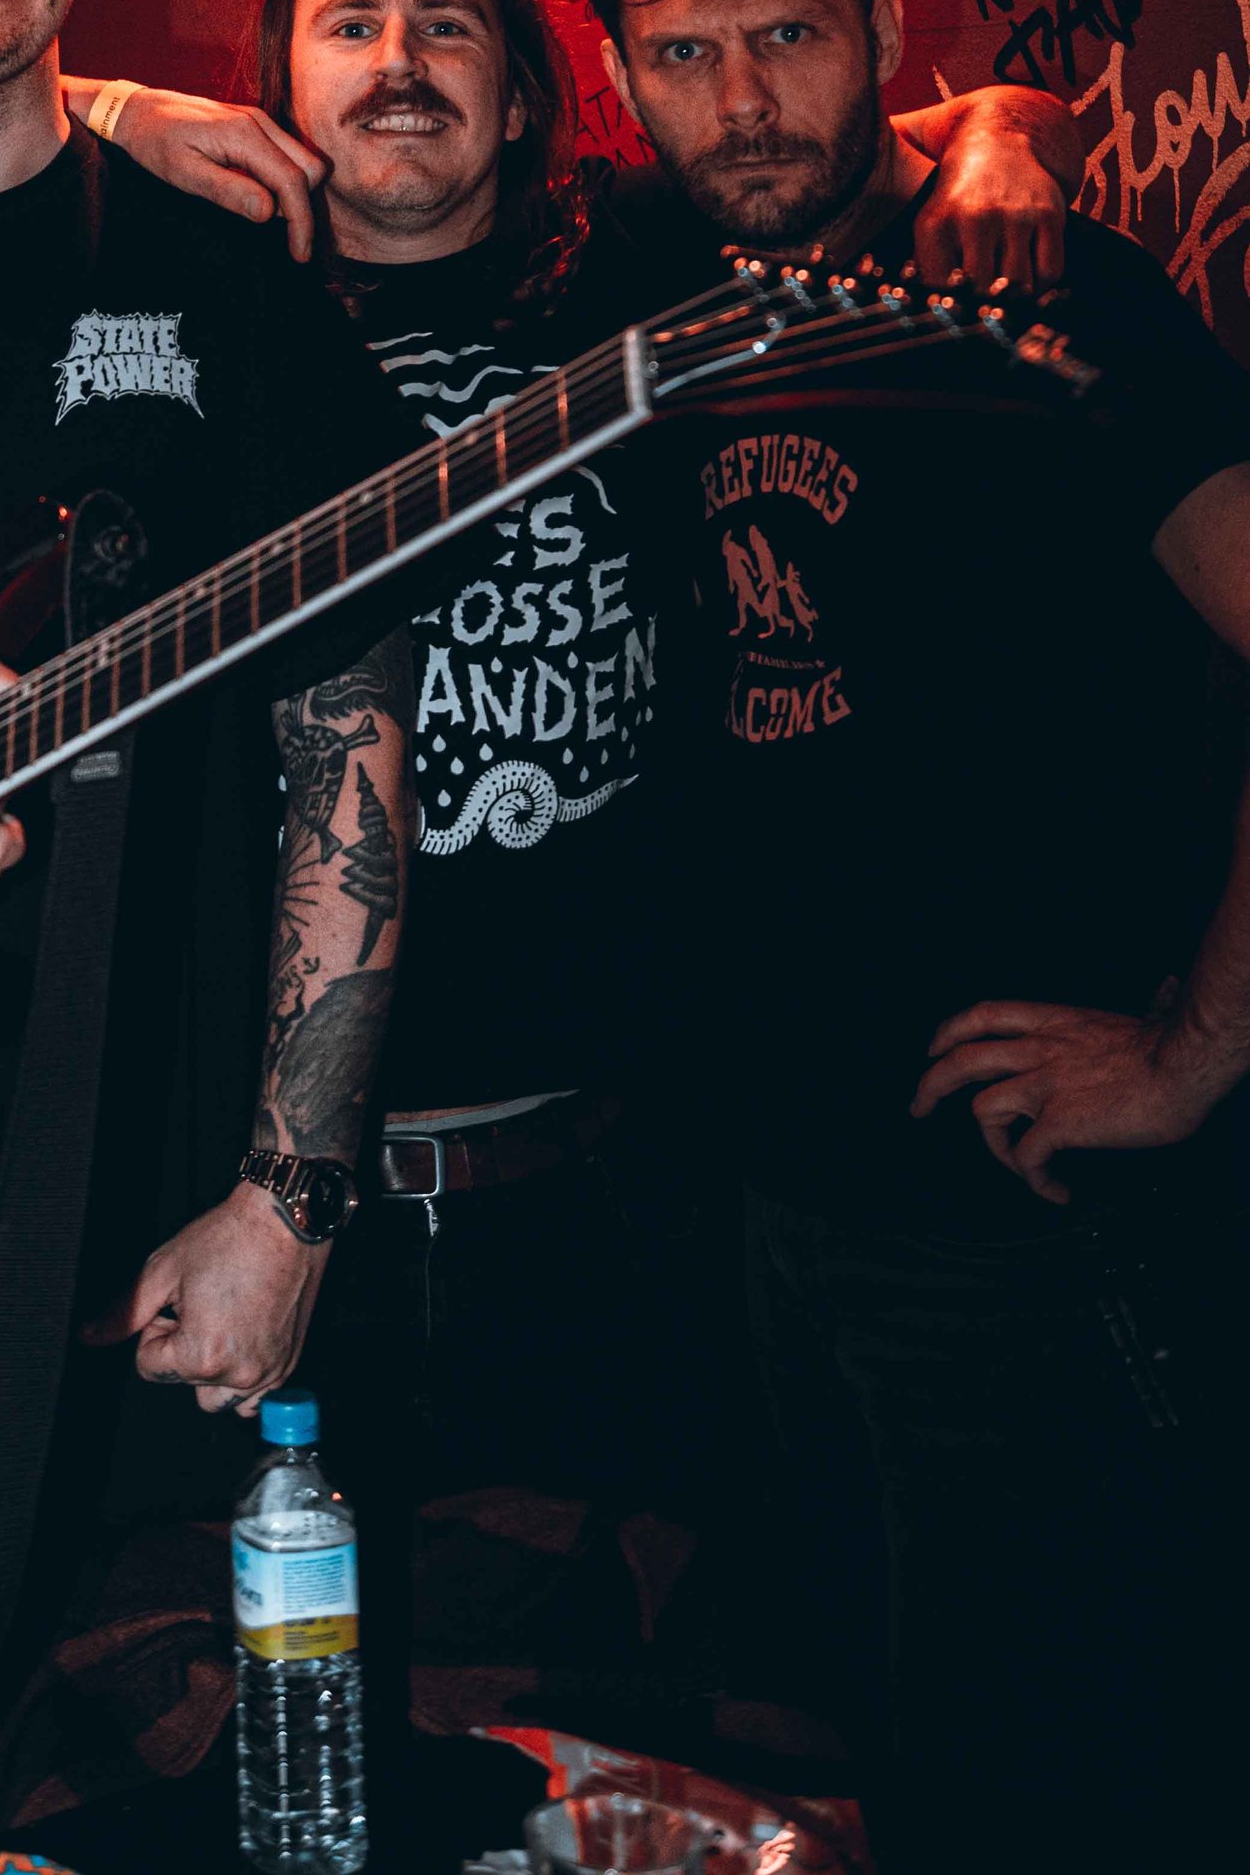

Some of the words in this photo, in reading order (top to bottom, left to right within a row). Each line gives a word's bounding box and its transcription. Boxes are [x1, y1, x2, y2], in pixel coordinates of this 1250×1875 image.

[99, 96, 121, 138] ainment
[65, 309, 183, 362] STATE
[52, 353, 204, 426] POWER
[700, 433, 859, 526] REFUGEES
[412, 554, 634, 648] OSSE
